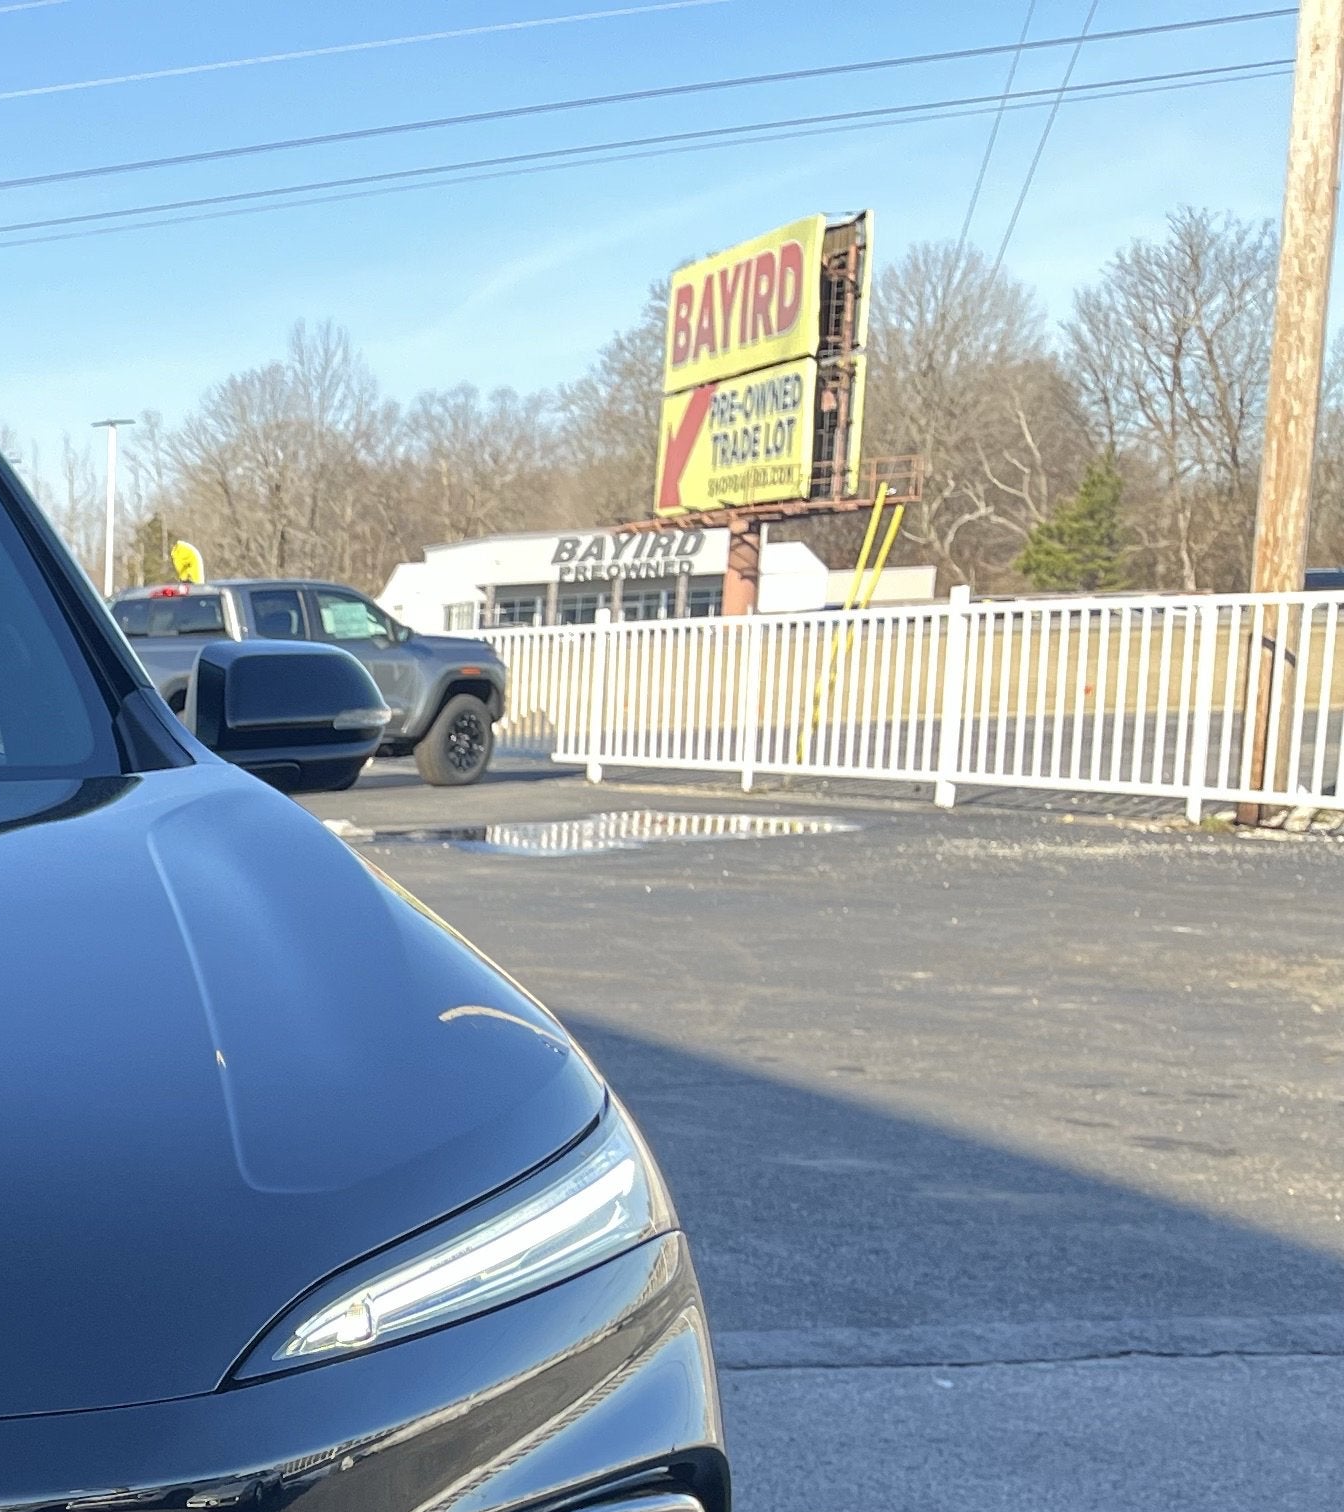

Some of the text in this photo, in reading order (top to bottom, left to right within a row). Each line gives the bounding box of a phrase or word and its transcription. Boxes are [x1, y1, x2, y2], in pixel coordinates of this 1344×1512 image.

[672, 241, 804, 369] BAYIRD
[709, 372, 803, 430] PRE-OWNED
[712, 416, 797, 472] TRADE LOT
[550, 528, 707, 565] BAYIRD
[558, 560, 696, 583] PREOWNED
